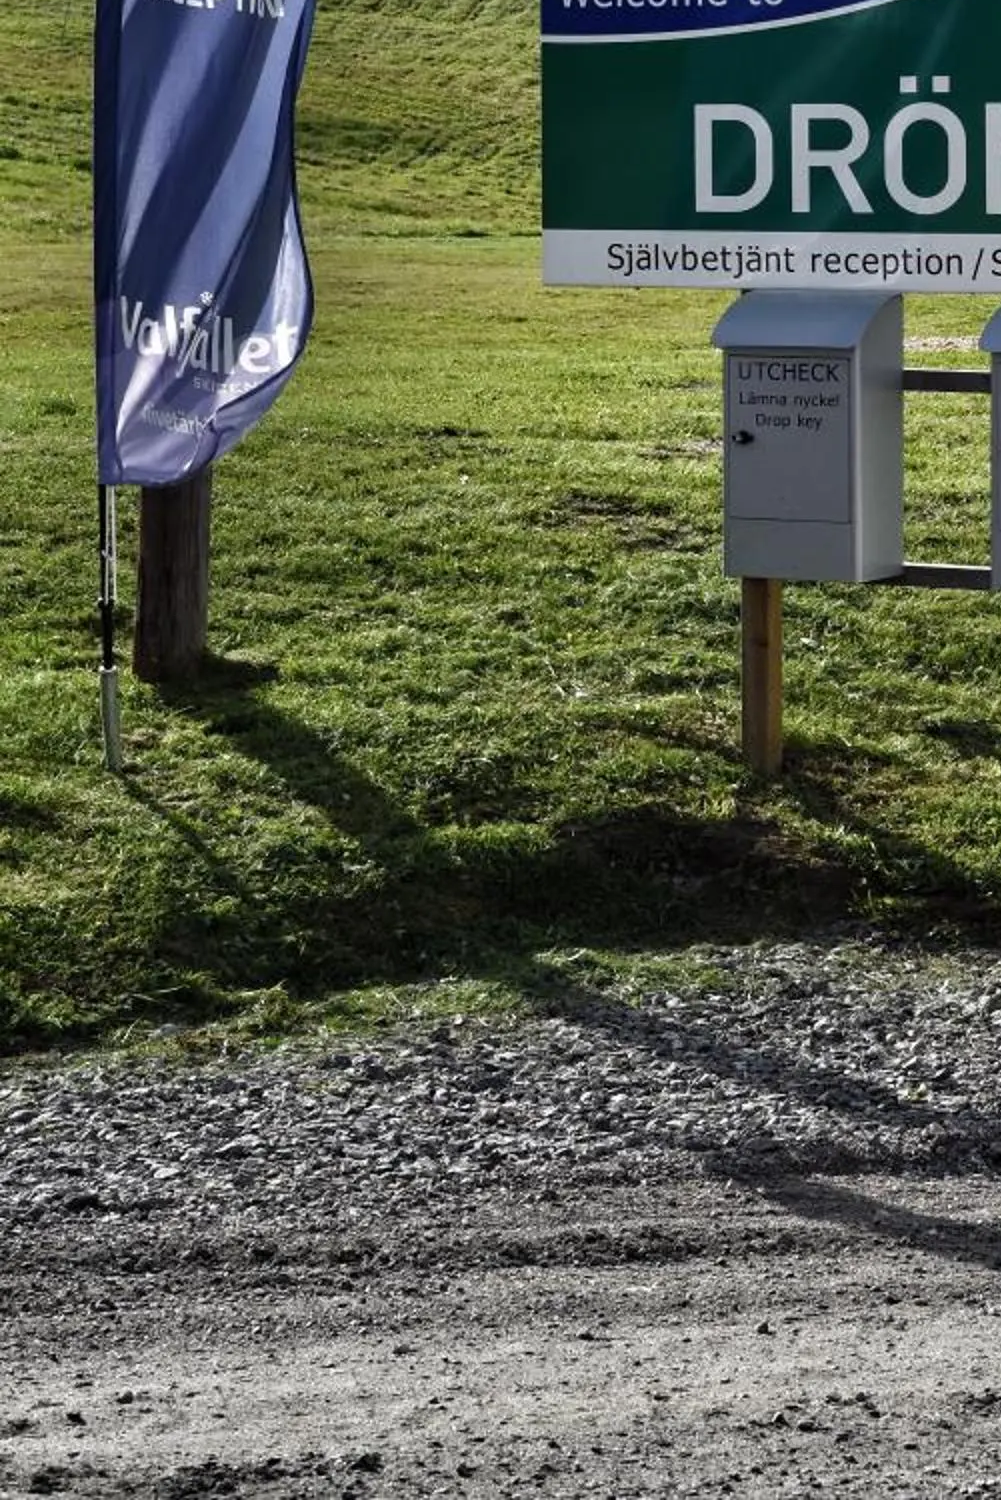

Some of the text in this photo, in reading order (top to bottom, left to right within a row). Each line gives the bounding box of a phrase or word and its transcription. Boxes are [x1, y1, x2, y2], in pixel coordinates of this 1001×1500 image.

[607, 243, 795, 277] Självbetjänt
[811, 248, 963, 281] reception
[738, 362, 840, 382] UTCHECK
[755, 413, 823, 431] Drop key
